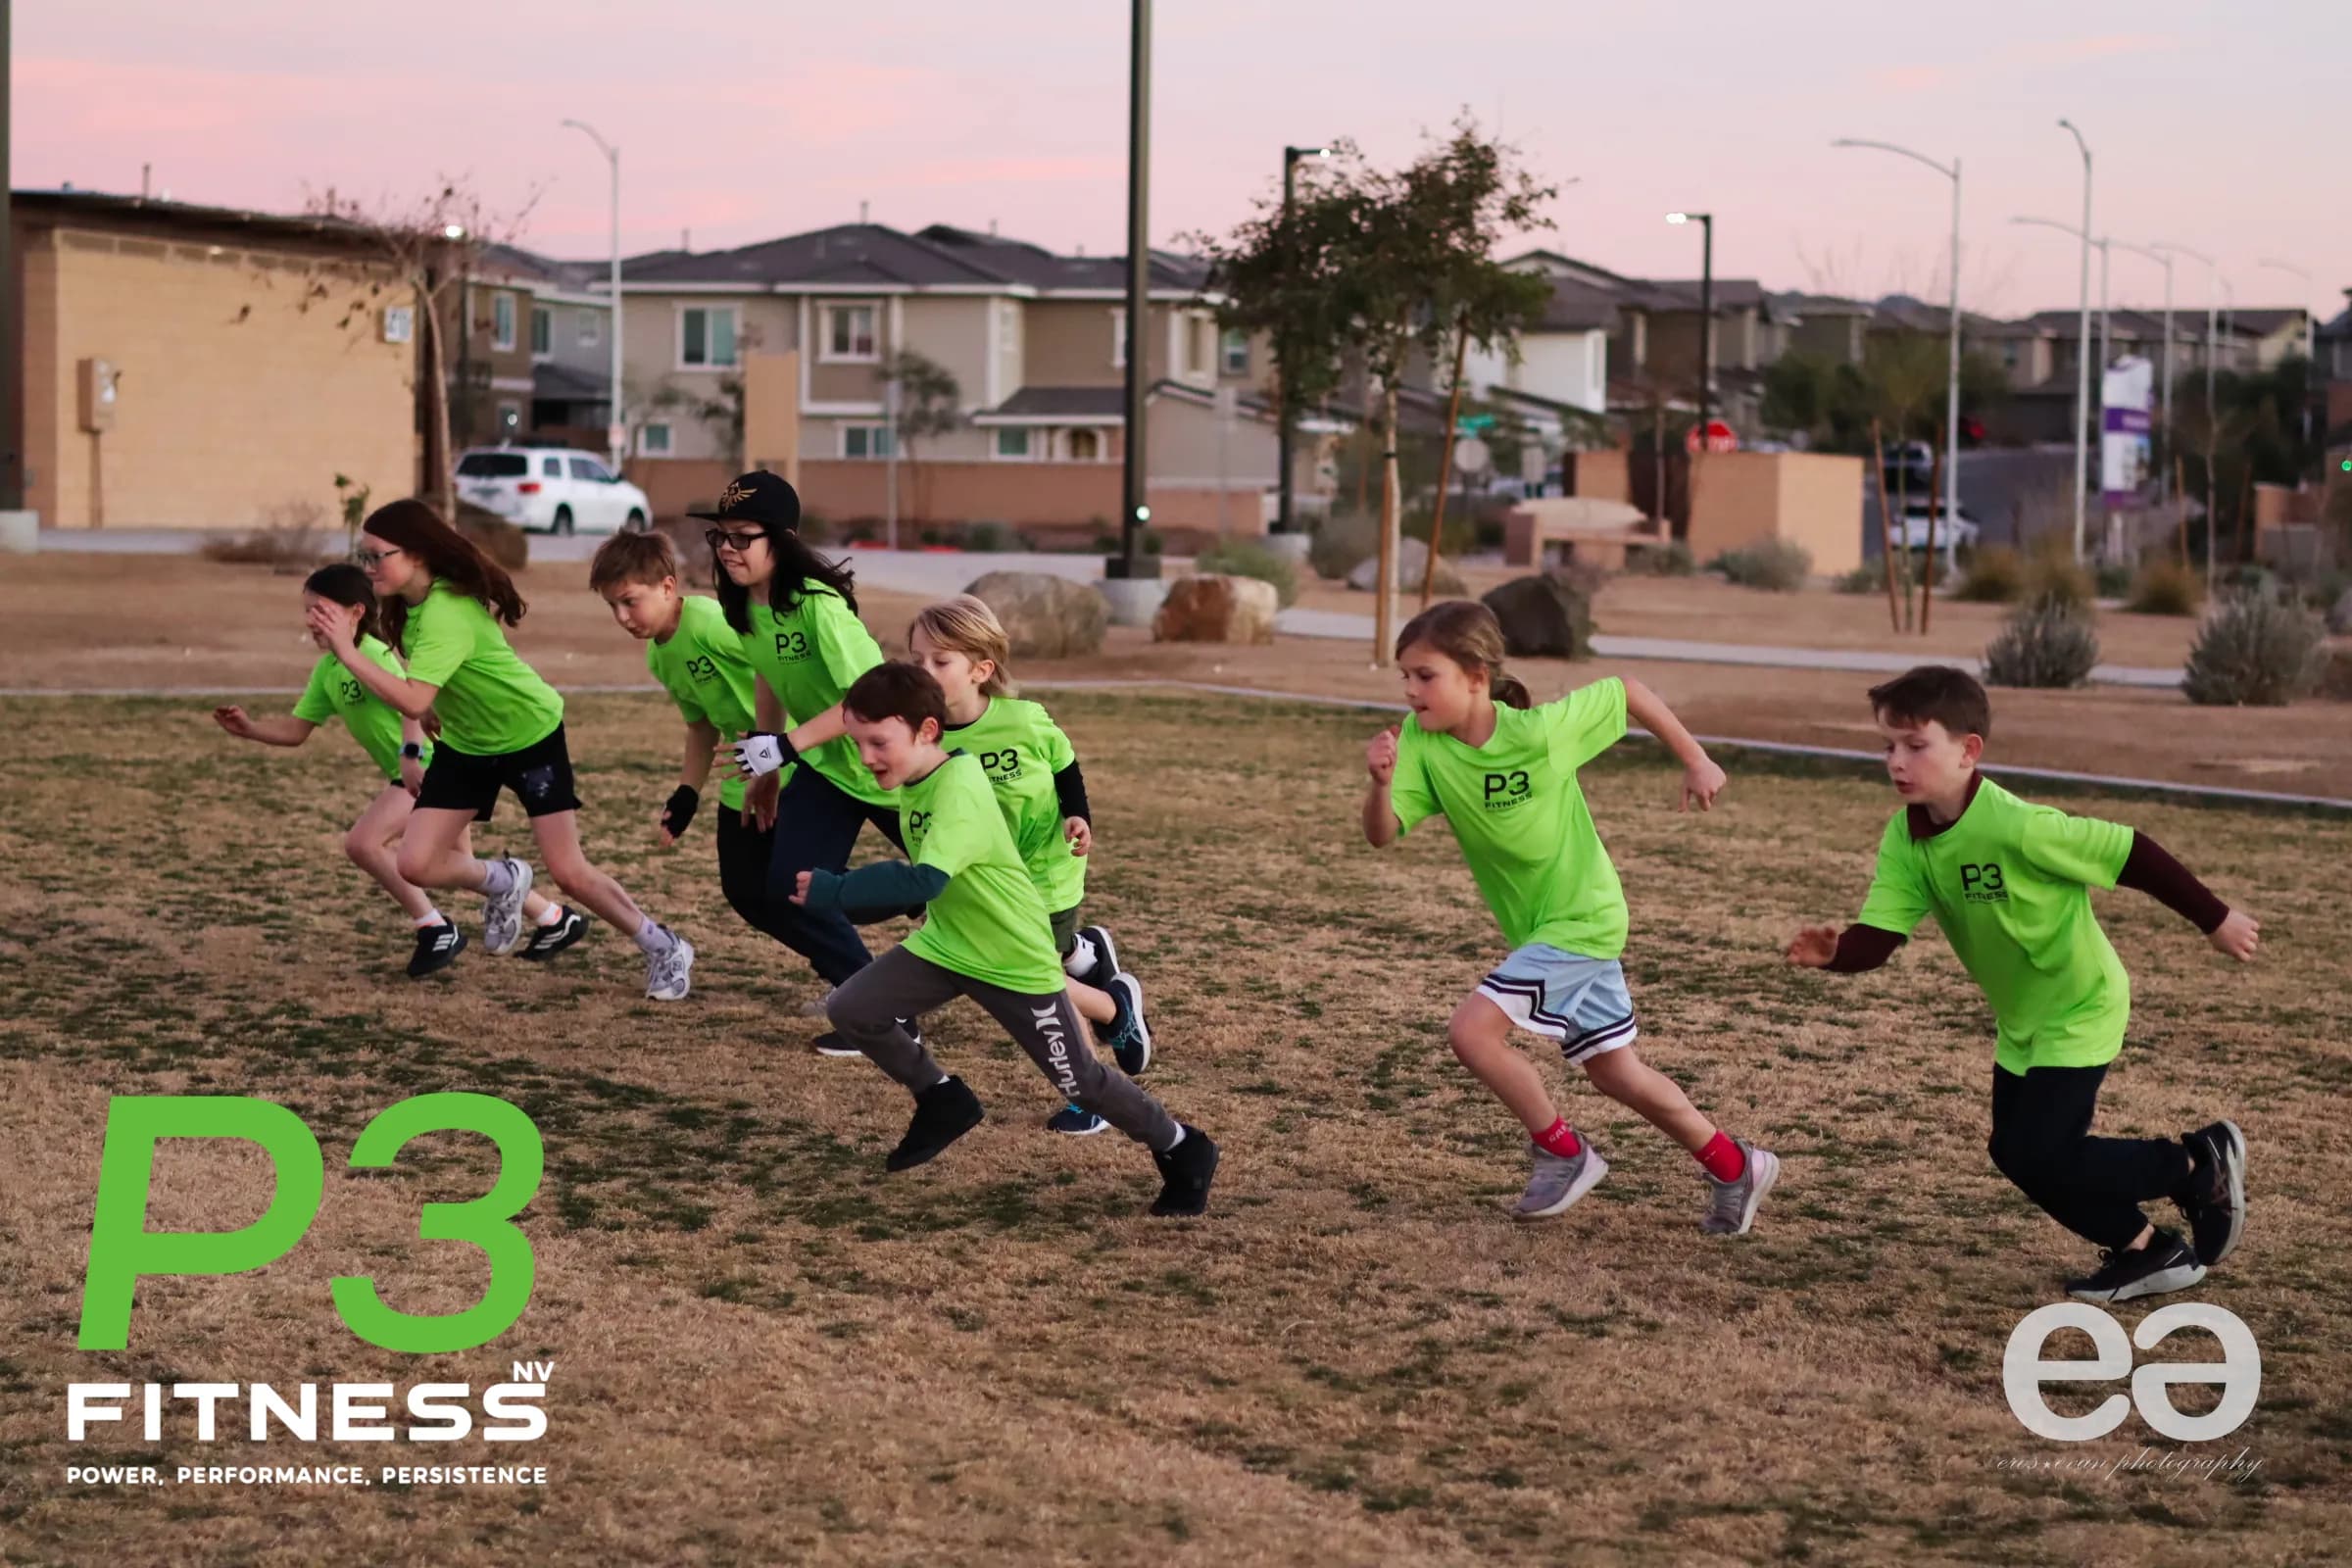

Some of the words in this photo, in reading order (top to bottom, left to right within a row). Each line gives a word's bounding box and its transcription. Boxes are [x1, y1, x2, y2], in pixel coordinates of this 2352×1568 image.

[775, 632, 807, 654] P3
[686, 656, 715, 677] P3
[980, 749, 1018, 772] P3
[989, 768, 1022, 783] TNESS
[1485, 771, 1529, 800] P3
[1484, 791, 1532, 808] FITNESS
[1960, 863, 2003, 890] P3
[1043, 1030, 1080, 1098] Hurley
